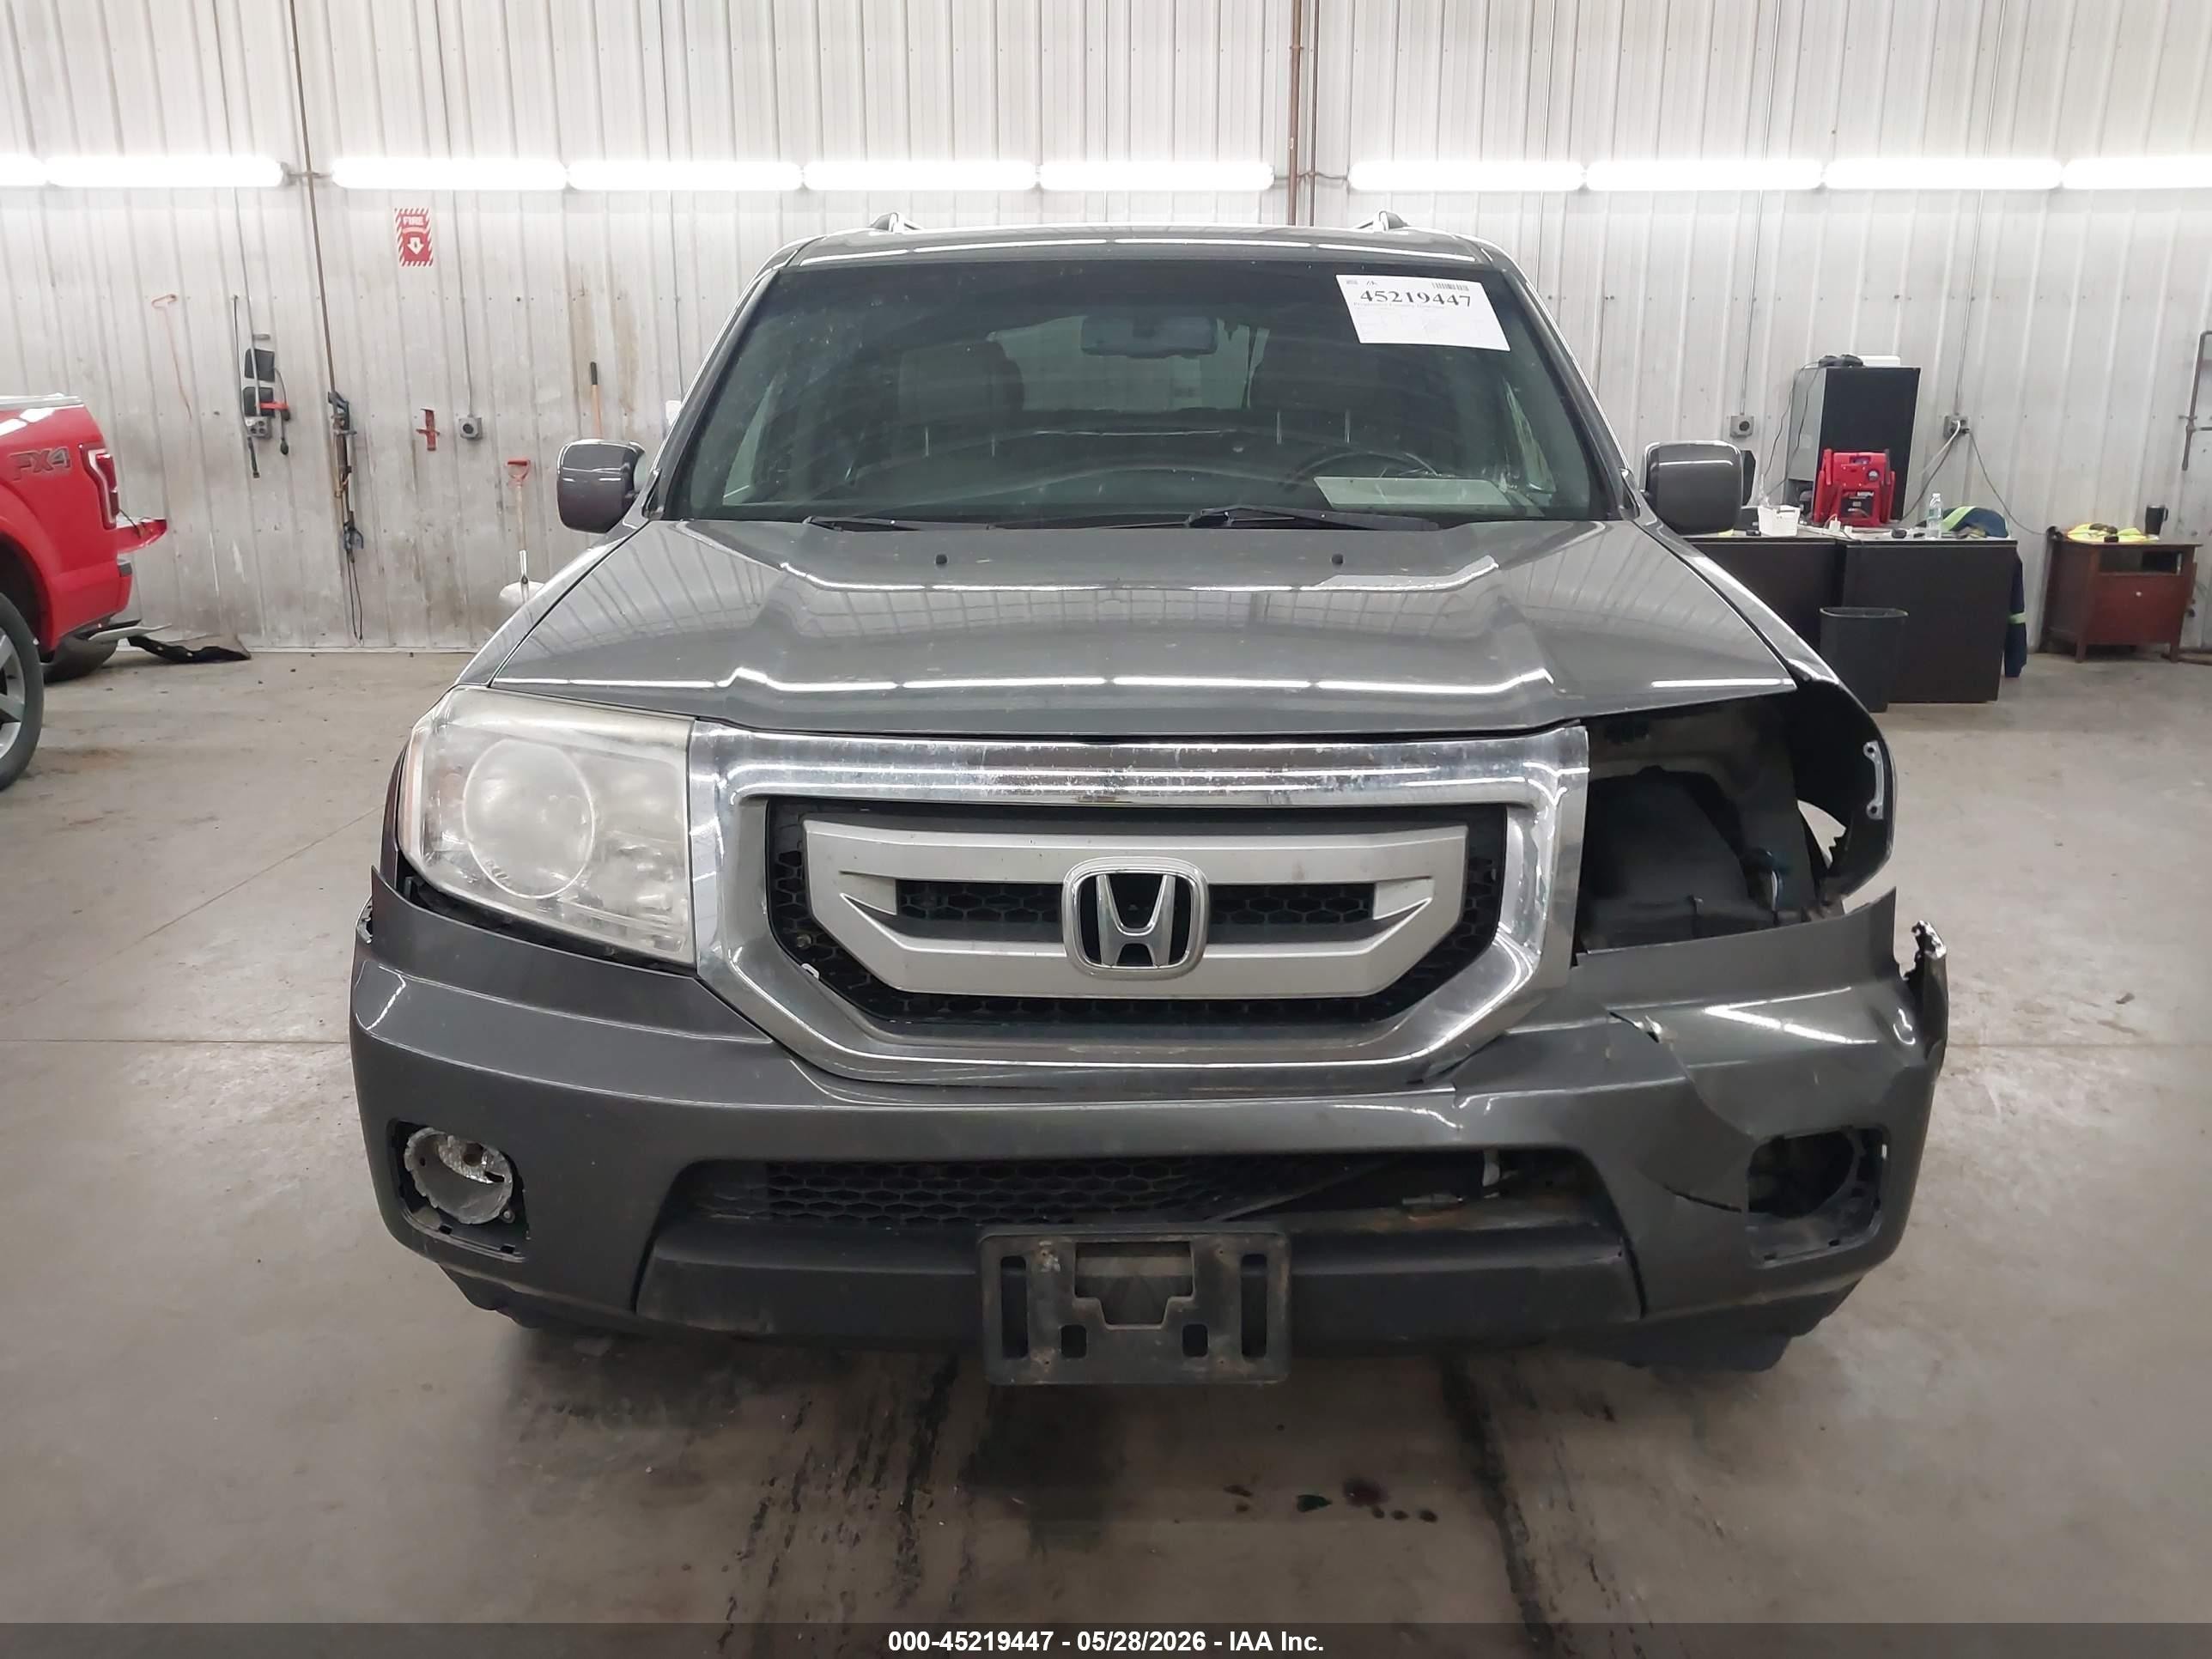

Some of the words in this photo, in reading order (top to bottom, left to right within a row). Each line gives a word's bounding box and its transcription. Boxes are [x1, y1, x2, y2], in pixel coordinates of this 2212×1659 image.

[403, 216, 424, 226] FIRE
[1360, 289, 1471, 307] 45219447
[9, 447, 71, 481] FX4
